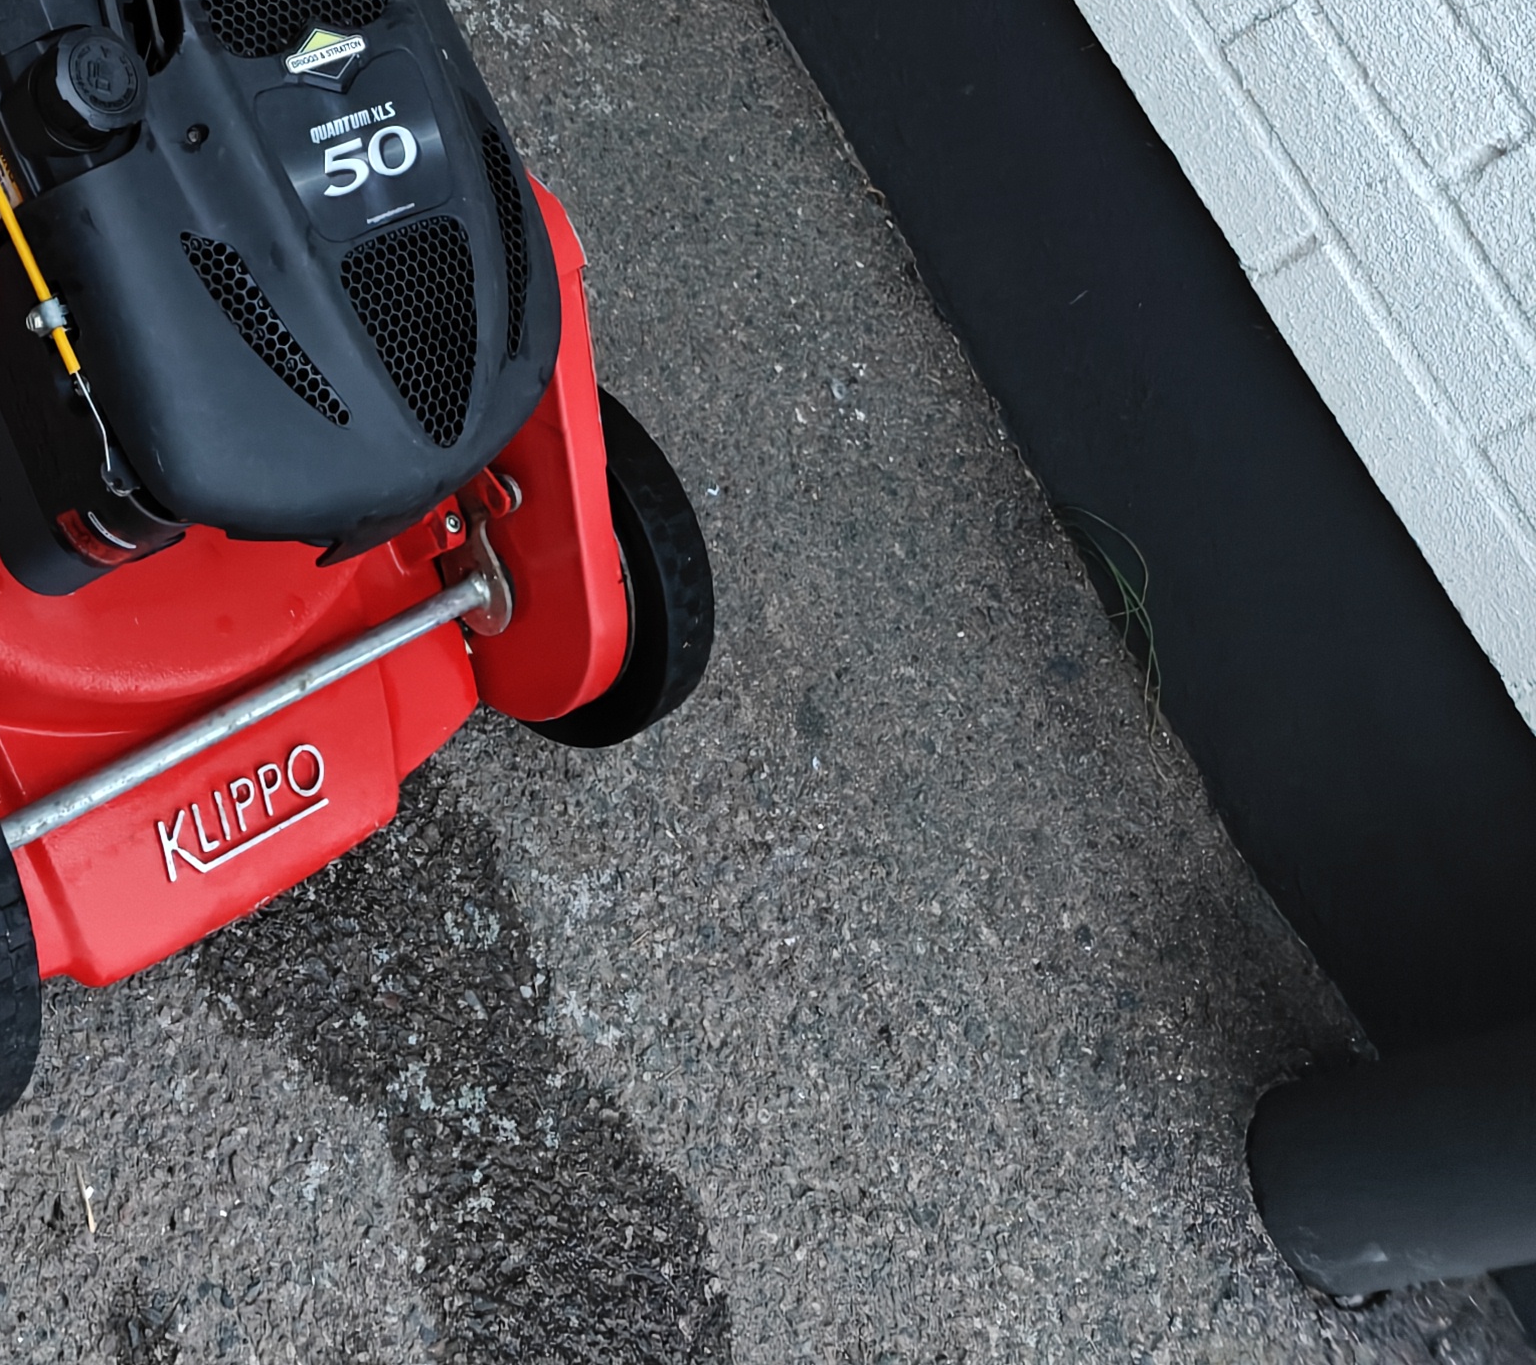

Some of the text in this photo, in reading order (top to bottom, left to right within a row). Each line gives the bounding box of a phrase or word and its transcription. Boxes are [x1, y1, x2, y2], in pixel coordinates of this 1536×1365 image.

[325, 40, 362, 58] STRATTON
[310, 101, 396, 144] QUANTUM XLS
[324, 125, 418, 197] 50
[157, 744, 329, 882] KLIPPO
